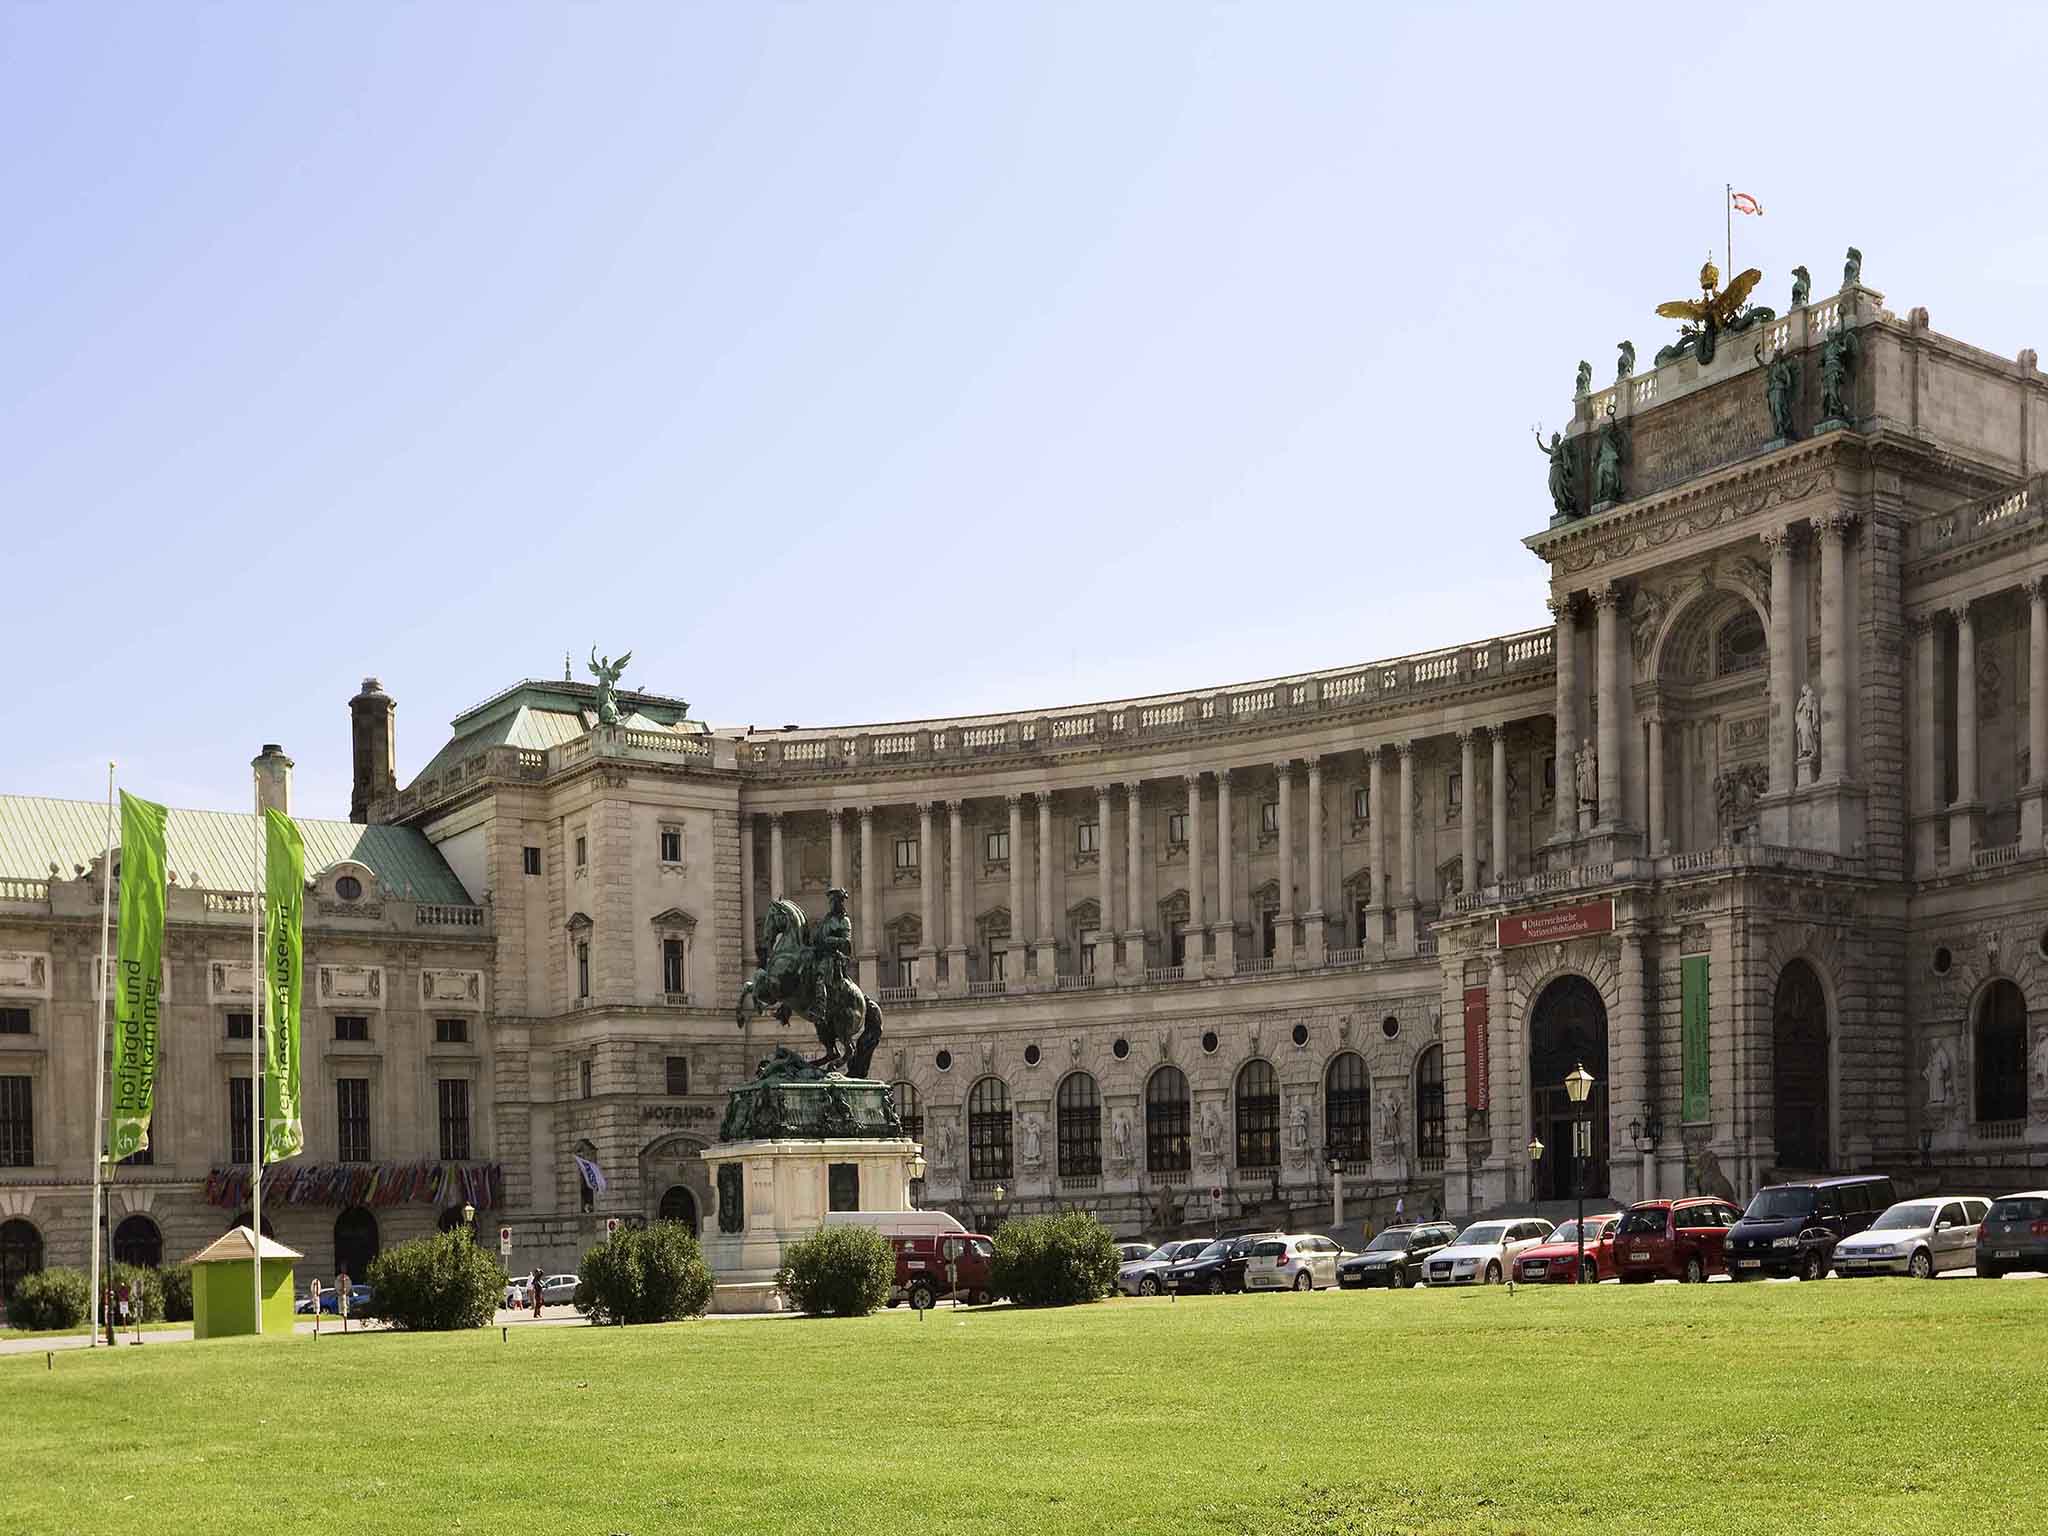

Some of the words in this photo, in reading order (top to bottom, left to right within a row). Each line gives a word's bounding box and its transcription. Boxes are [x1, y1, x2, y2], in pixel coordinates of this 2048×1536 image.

[121, 960, 141, 1005] und
[274, 904, 289, 1006] museum
[116, 1011, 143, 1110] hofjagd-
[275, 1016, 290, 1111] ephesos
[643, 1106, 717, 1120] HOFBURG
